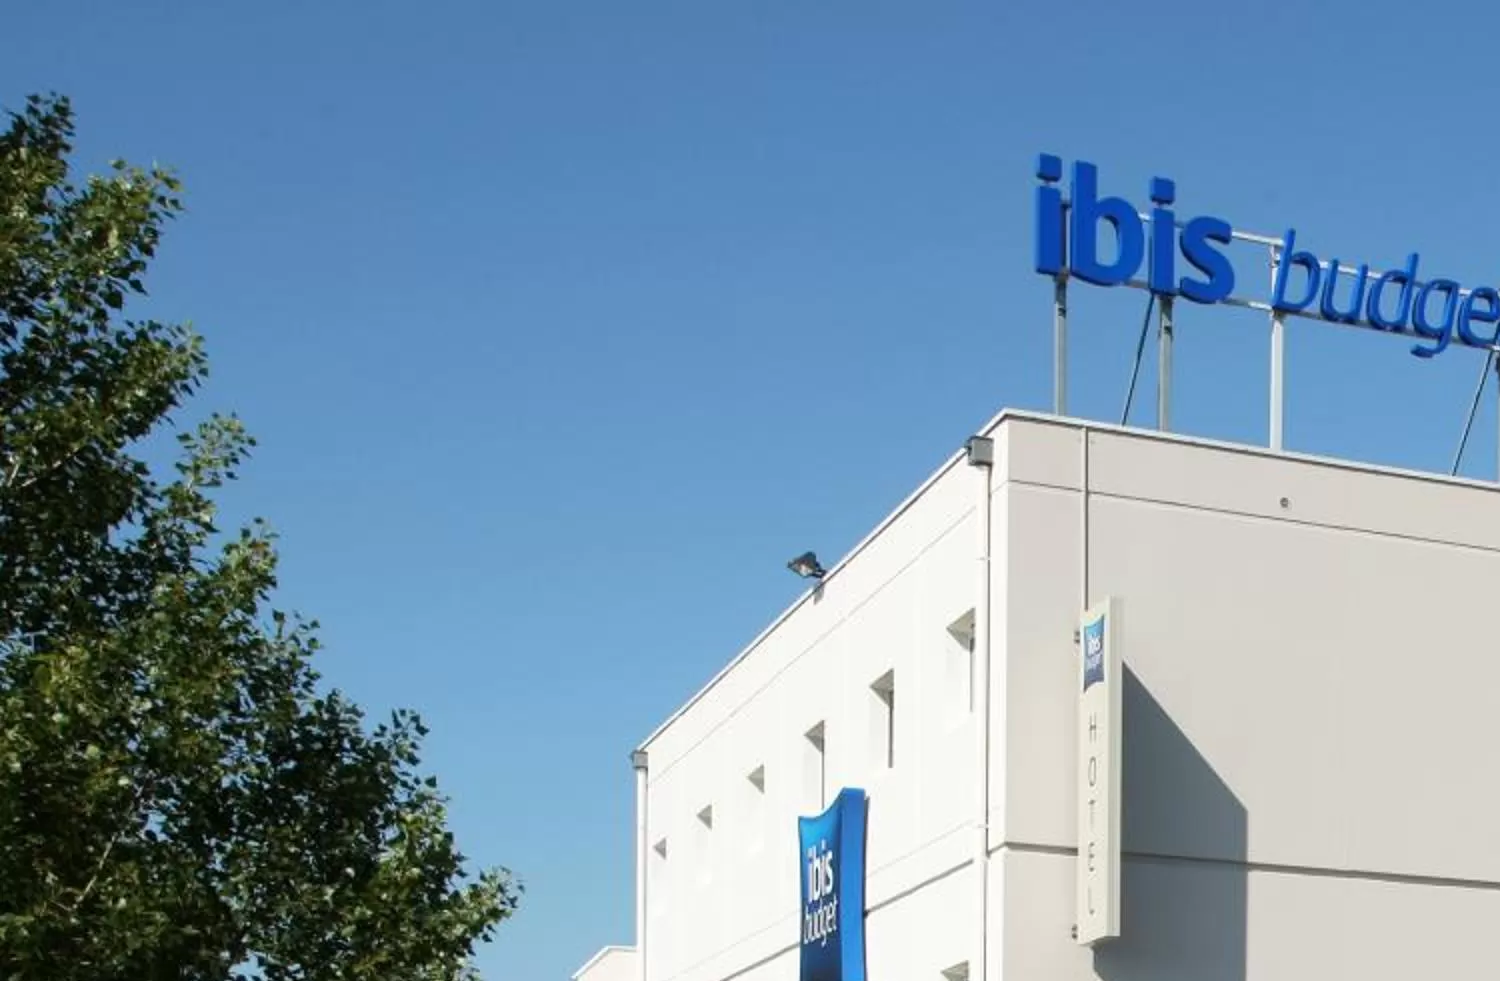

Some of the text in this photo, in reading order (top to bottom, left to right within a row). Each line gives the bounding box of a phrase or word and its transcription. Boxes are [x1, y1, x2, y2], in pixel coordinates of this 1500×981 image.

[1035, 152, 1236, 303] ibis
[807, 839, 834, 903] ibis
[803, 894, 838, 947] budget
